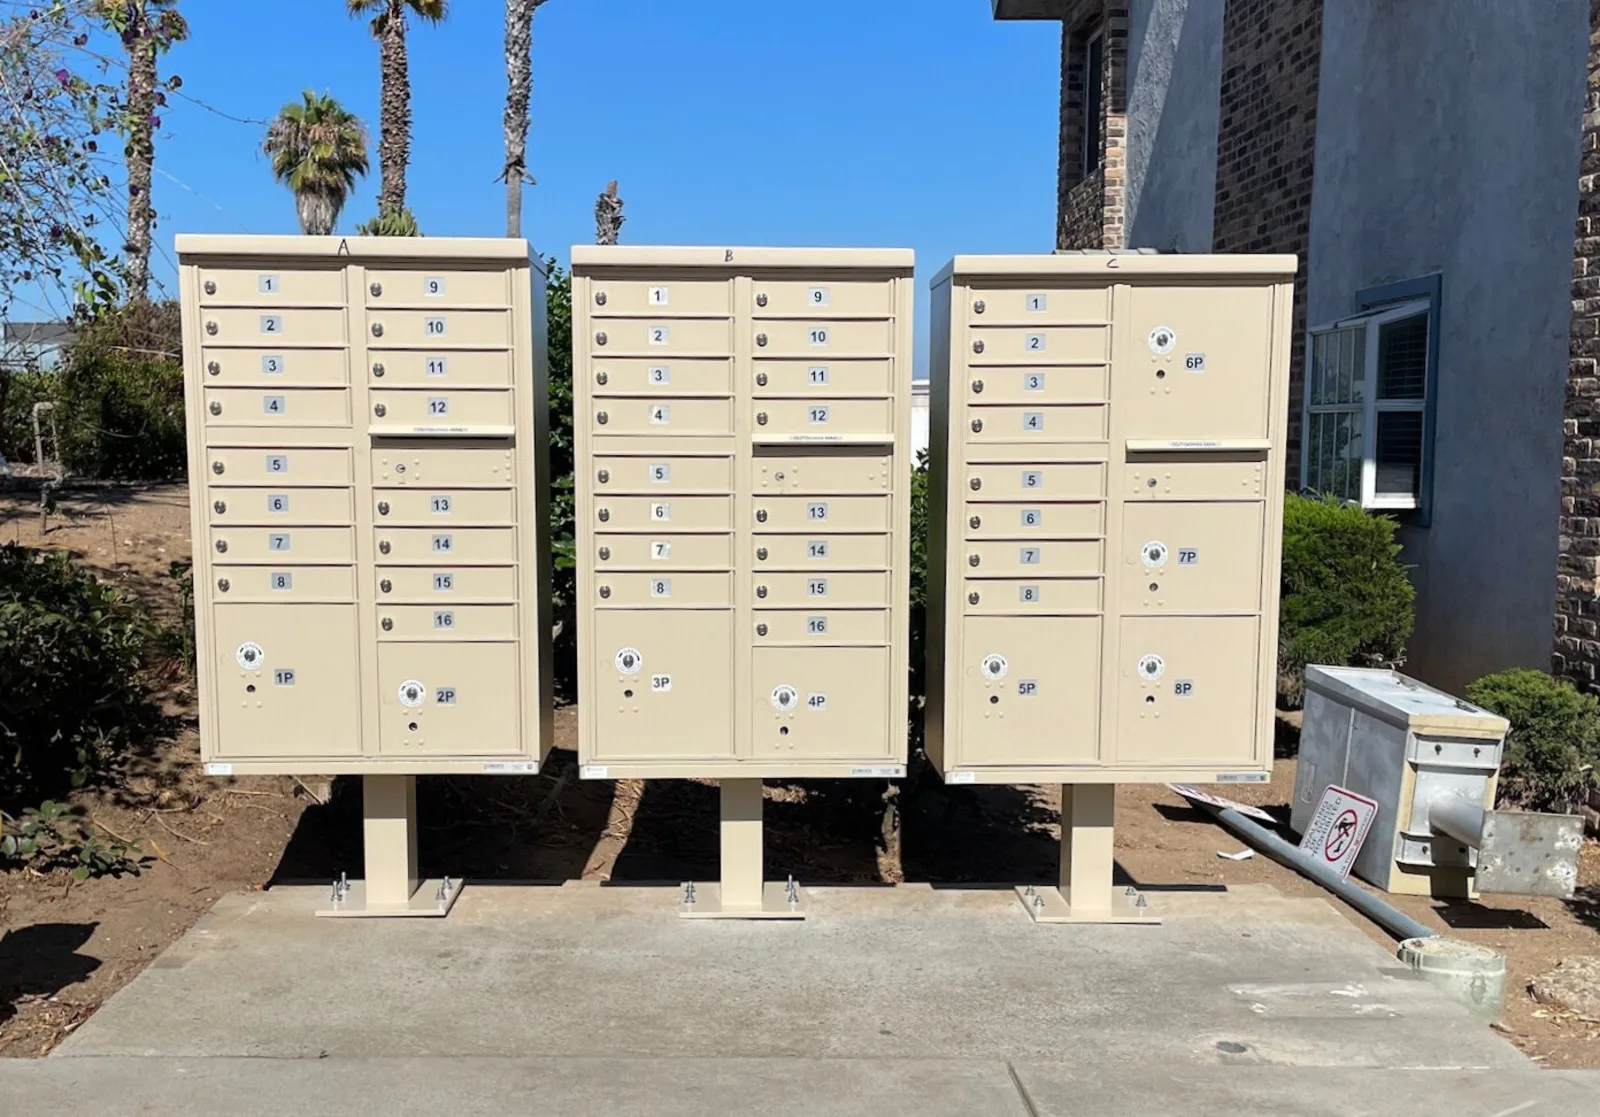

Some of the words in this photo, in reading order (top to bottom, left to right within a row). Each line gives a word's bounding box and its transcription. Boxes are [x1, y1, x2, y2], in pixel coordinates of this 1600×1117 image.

[338, 238, 350, 255] A
[724, 249, 733, 262] B
[1106, 258, 1119, 268] C
[265, 279, 272, 290] 1
[430, 281, 438, 294] 9
[655, 290, 661, 301] 1
[814, 291, 822, 302] 9
[1033, 298, 1039, 309] 1
[266, 319, 275, 331] 2
[428, 321, 444, 333] 10
[654, 330, 662, 342] 2
[811, 331, 826, 342] 10
[1031, 337, 1039, 349] 2
[268, 360, 277, 372] 3
[429, 361, 443, 373] 11
[1186, 357, 1203, 369] 6P
[655, 369, 662, 381] 3
[811, 370, 824, 382] 11
[1030, 376, 1038, 388] 3
[270, 400, 278, 412] 4
[431, 401, 446, 413] 12
[655, 409, 663, 420] 4
[811, 410, 826, 421] 12
[1029, 416, 1037, 427] 4
[273, 459, 281, 471] 5
[656, 468, 663, 480] 5
[1028, 475, 1036, 486] 5
[274, 498, 282, 510] 6
[434, 499, 449, 511] 13
[656, 506, 664, 518] 6
[810, 507, 825, 518] 13
[1026, 513, 1034, 524] 6
[275, 538, 283, 549] 7
[435, 538, 450, 549] 14
[656, 544, 664, 556] 7
[810, 545, 825, 556] 14
[1026, 551, 1034, 562] 7
[1179, 551, 1197, 563] 7P
[277, 576, 285, 588] 8
[436, 576, 451, 588] 15
[656, 582, 664, 594] 8
[810, 583, 824, 594] 15
[1025, 589, 1032, 600] 8
[437, 614, 452, 626] 16
[810, 620, 825, 632] 16
[276, 672, 293, 683] 1P
[653, 677, 670, 688] 3P
[1019, 683, 1036, 695] 5P
[1175, 683, 1192, 694] 8P
[437, 691, 454, 703] 2P
[808, 696, 825, 706] 4P
[1303, 800, 1329, 848] WALKING
[1309, 837, 1317, 850] OF
[1317, 803, 1333, 833] DOGS
